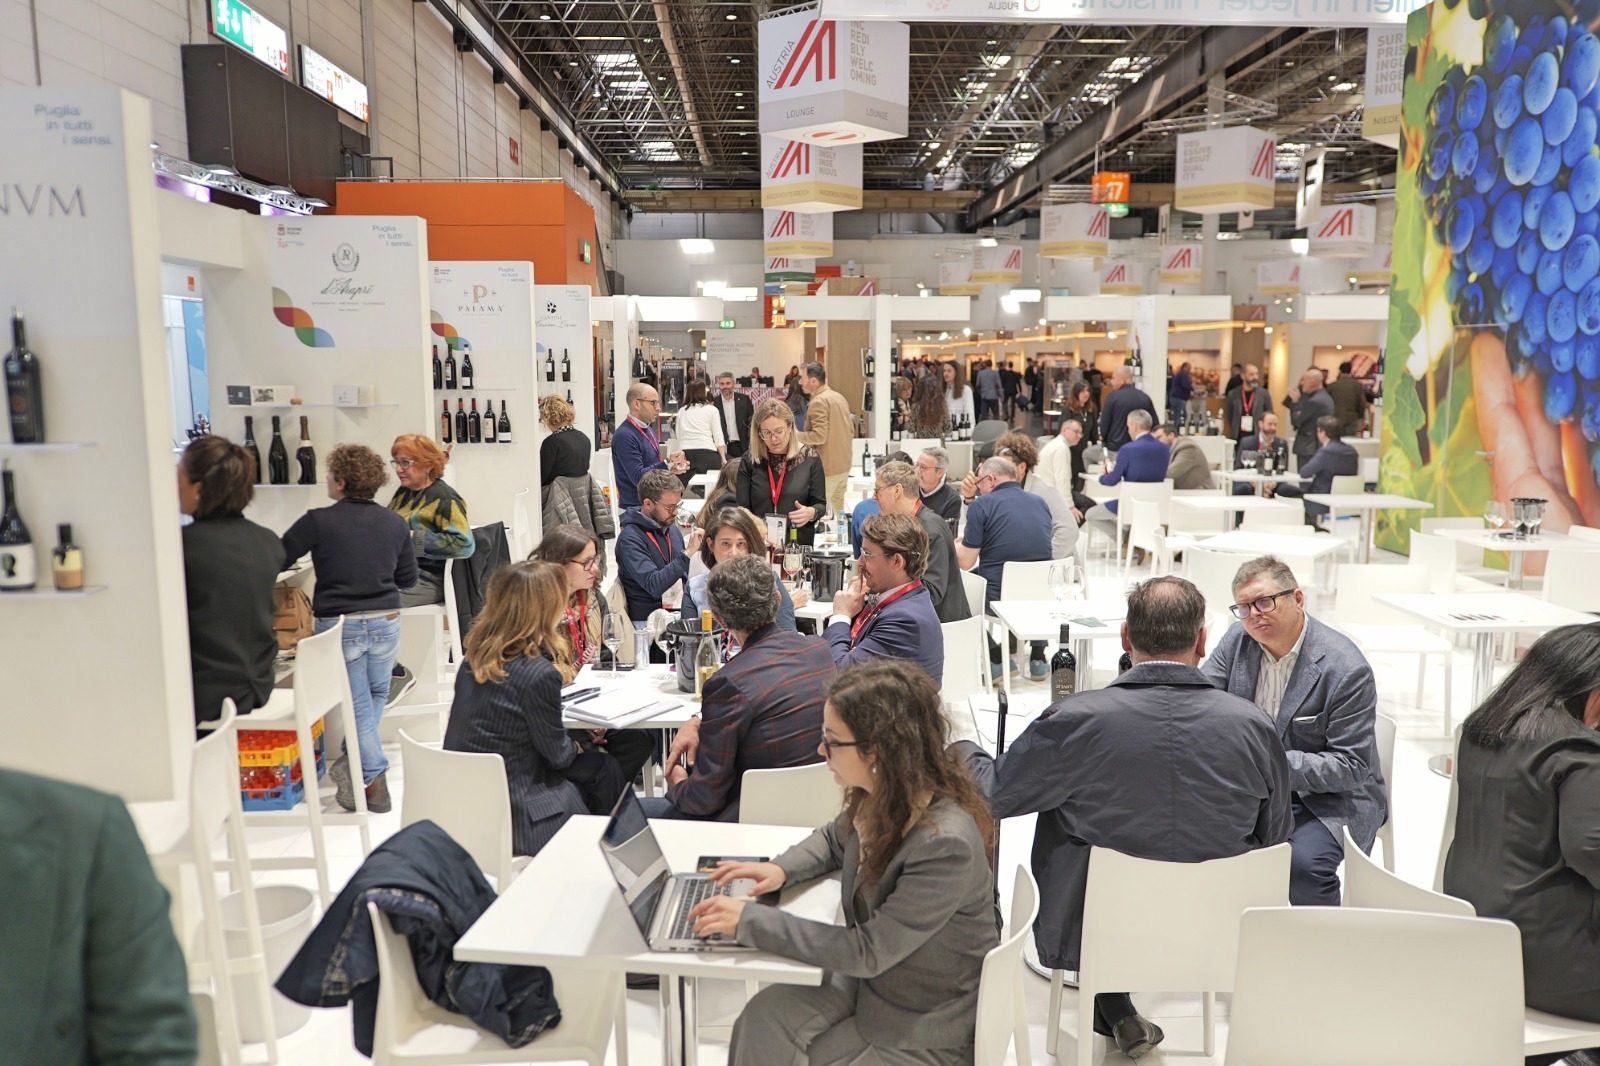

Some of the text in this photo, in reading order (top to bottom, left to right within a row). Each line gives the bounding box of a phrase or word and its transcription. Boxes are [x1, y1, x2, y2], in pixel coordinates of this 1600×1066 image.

[850, 29, 869, 45] REDI
[1377, 33, 1404, 47] SUR
[850, 43, 865, 57] BLY
[766, 40, 796, 89] AUSTRIA
[850, 55, 874, 72] WELC
[850, 69, 876, 86] OMING
[34, 104, 81, 118] Puglia
[786, 106, 815, 119] LOUNGE
[866, 107, 889, 121] LOUNGE
[46, 120, 93, 130] in tutti
[71, 135, 113, 145] sensi.
[1303, 159, 1317, 206] F
[372, 224, 396, 232] Puglia
[472, 284, 488, 304] P
